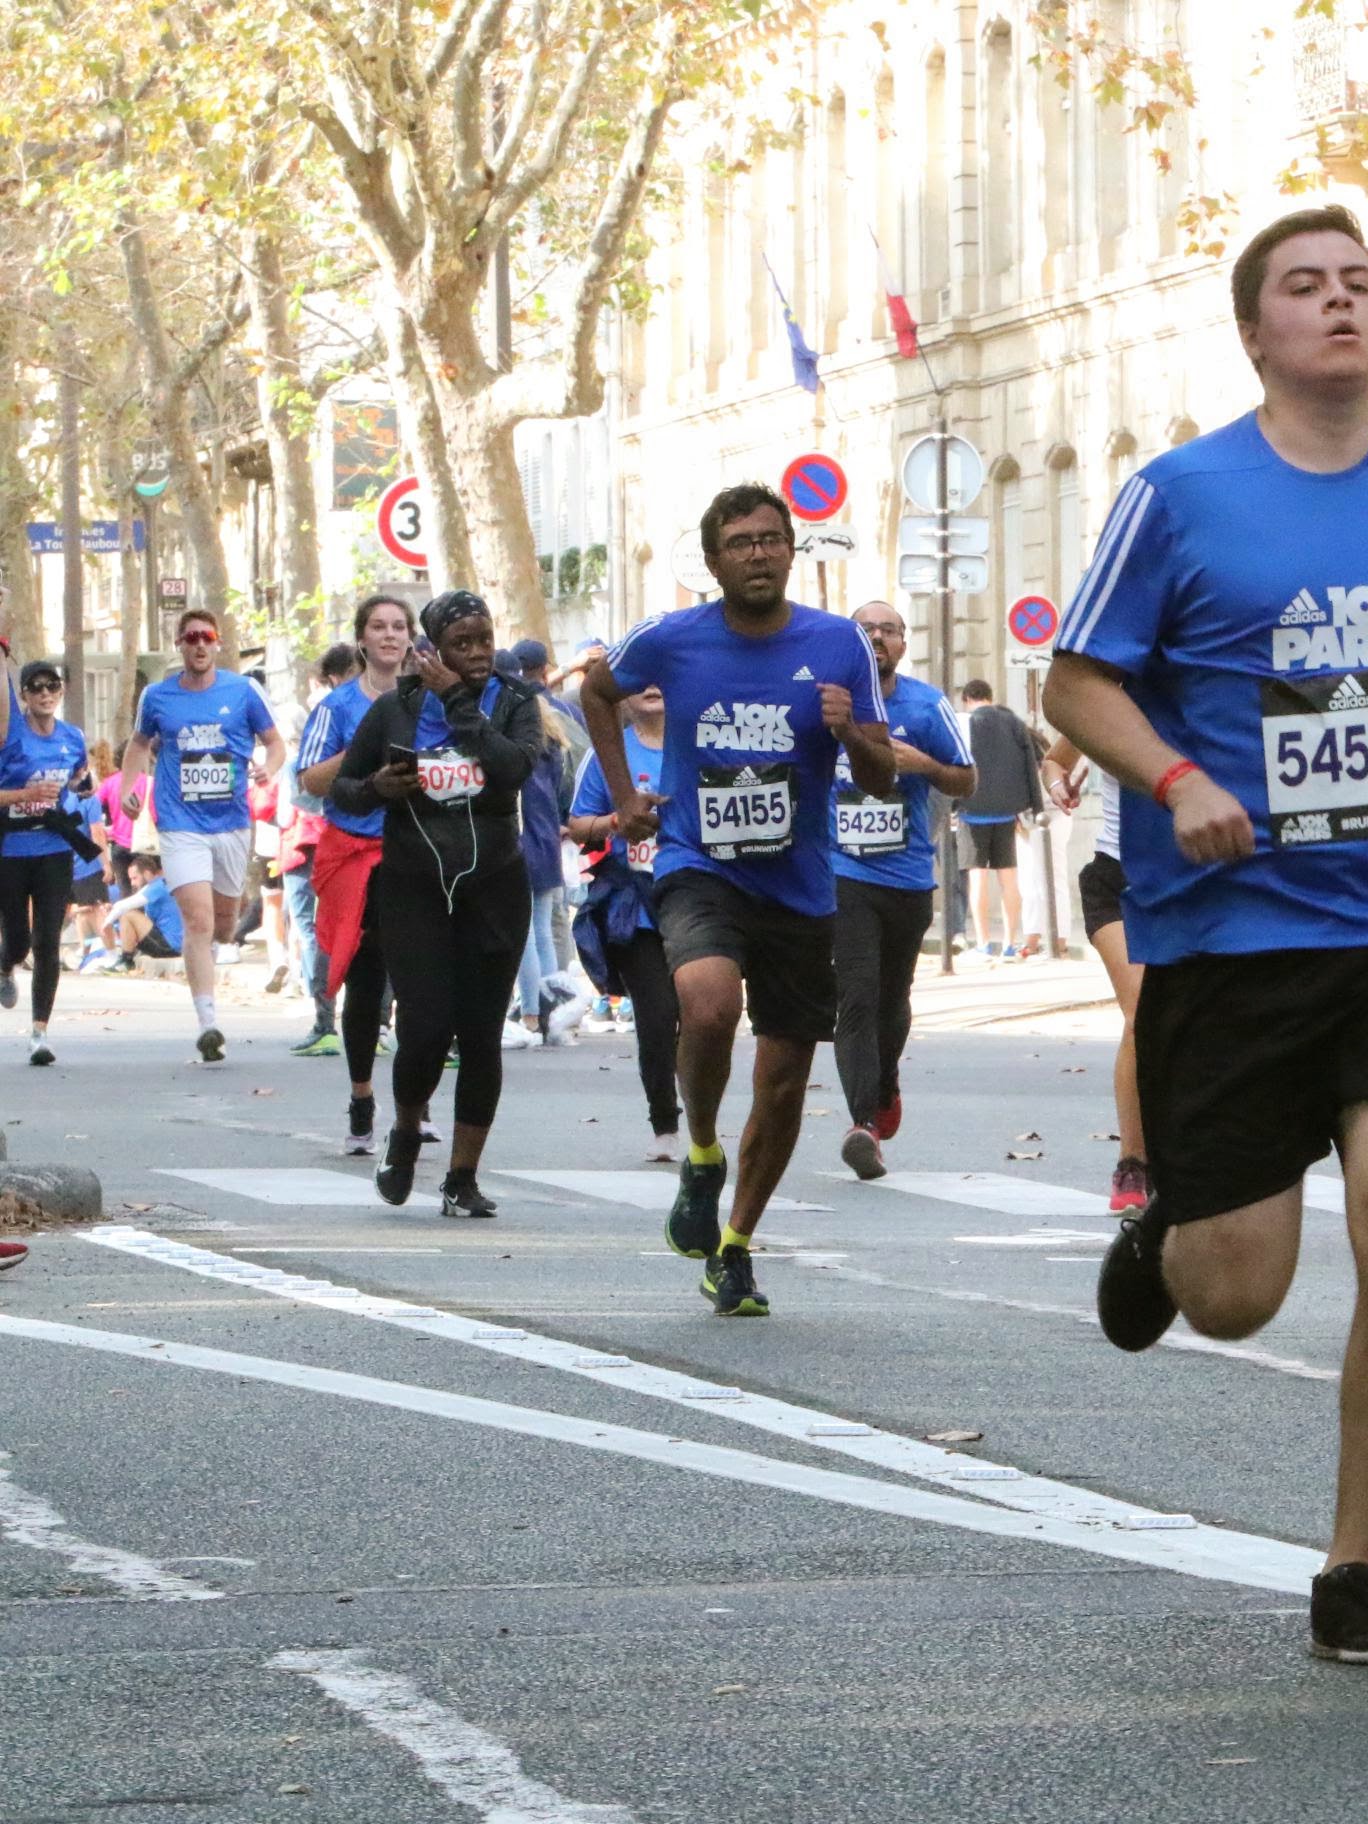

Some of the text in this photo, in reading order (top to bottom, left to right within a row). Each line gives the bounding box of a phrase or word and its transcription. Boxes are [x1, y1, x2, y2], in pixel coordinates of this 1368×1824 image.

[396, 500, 421, 542] 3
[1279, 609, 1327, 625] adidas
[700, 702, 793, 728] adidas 10K
[697, 723, 795, 752] PARIS
[182, 768, 229, 785] 30902
[706, 791, 786, 829] 54155
[839, 810, 901, 833] 54236
